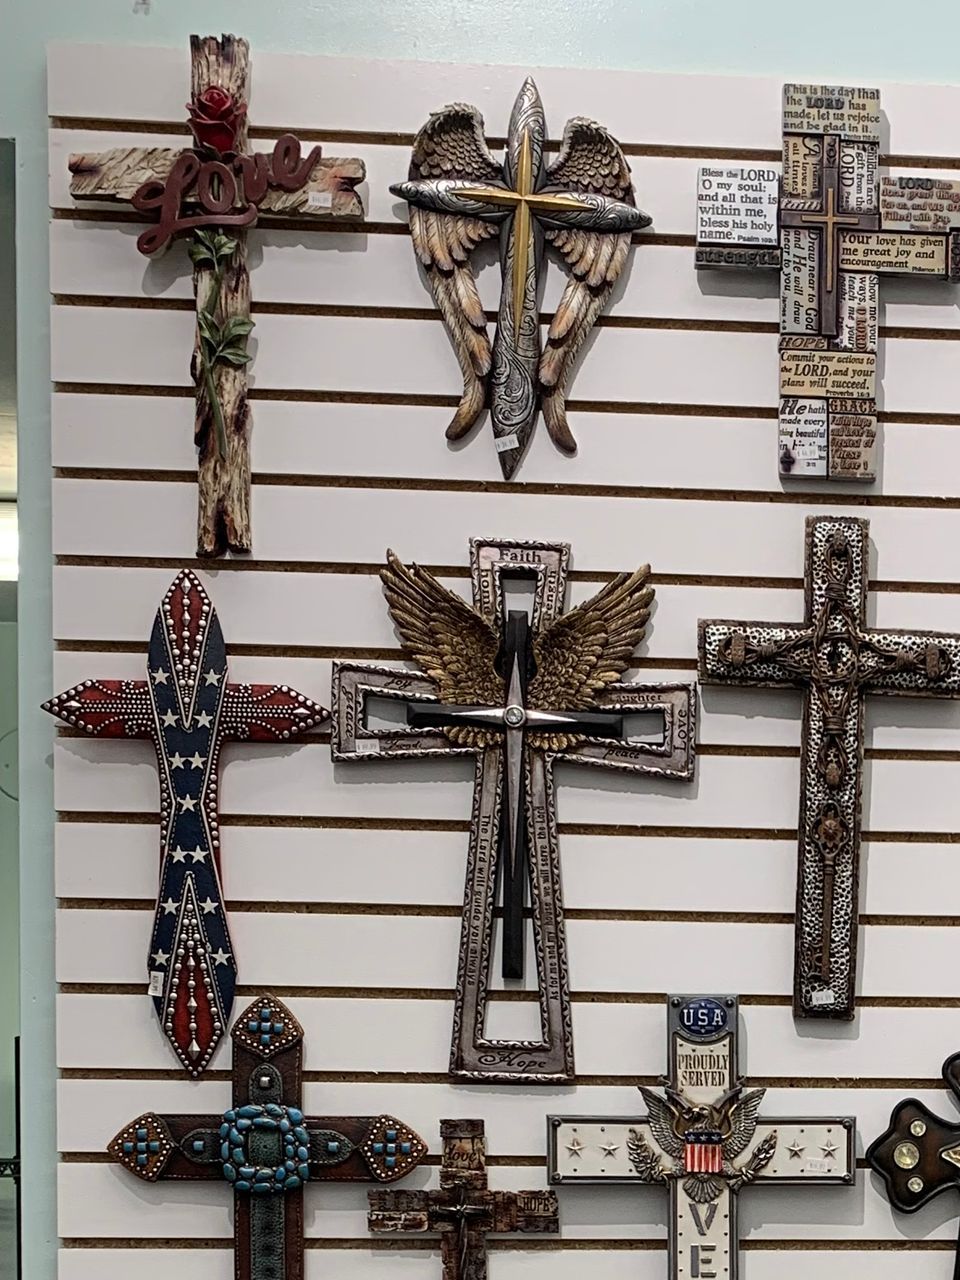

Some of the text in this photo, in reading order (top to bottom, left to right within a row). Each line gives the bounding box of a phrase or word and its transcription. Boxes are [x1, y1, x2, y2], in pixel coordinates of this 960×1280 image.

[784, 84, 807, 95] This
[810, 86, 817, 95] is
[821, 86, 835, 96] the
[838, 87, 855, 99] day
[806, 97, 844, 109] LORD
[849, 100, 866, 110] has
[817, 111, 830, 120] let
[848, 113, 880, 123] rejoice
[783, 121, 803, 129] and
[823, 123, 845, 132] glad
[849, 123, 858, 132] in
[702, 168, 723, 177] Bless
[841, 146, 854, 188] LORD
[702, 179, 712, 190] O
[738, 183, 766, 192] soul:
[899, 177, 934, 190] LORD
[131, 132, 322, 258] Love
[698, 192, 777, 204] and all that is
[699, 205, 766, 218] within me,
[700, 218, 773, 232] bless his holy
[700, 230, 735, 239] name.
[841, 232, 944, 248] Your love has given
[808, 230, 820, 263] Draw
[842, 248, 935, 259] me great joy and
[783, 230, 791, 291] near to you
[841, 258, 908, 269] encouragement
[793, 231, 807, 324] and He will draw
[858, 276, 866, 305] ways,
[869, 275, 879, 303] Show
[808, 294, 816, 303] to
[805, 307, 818, 331] God
[846, 276, 856, 348] teach me your
[869, 306, 877, 321] me
[780, 337, 825, 348] HOPE
[781, 352, 875, 365] Commit your actions to
[794, 364, 832, 377] LORD,
[833, 368, 848, 376] and
[851, 370, 875, 378] your
[782, 378, 869, 390] plans will succeed.
[780, 400, 825, 415] He hath
[830, 400, 876, 413] GRACE
[780, 416, 825, 426] made every
[796, 429, 825, 438] beautiful
[499, 548, 542, 563] Faith
[673, 709, 687, 752] Love
[481, 815, 491, 836] The
[478, 839, 489, 863] Lord
[478, 866, 488, 888] will
[534, 805, 559, 1001] As for and will serve Lord
[471, 928, 483, 947] you
[683, 1009, 723, 1025] USA
[478, 1050, 547, 1071] Hope
[678, 1054, 728, 1070] PROUDLY
[681, 1071, 725, 1086] SERVED
[523, 1197, 550, 1212] HOPE
